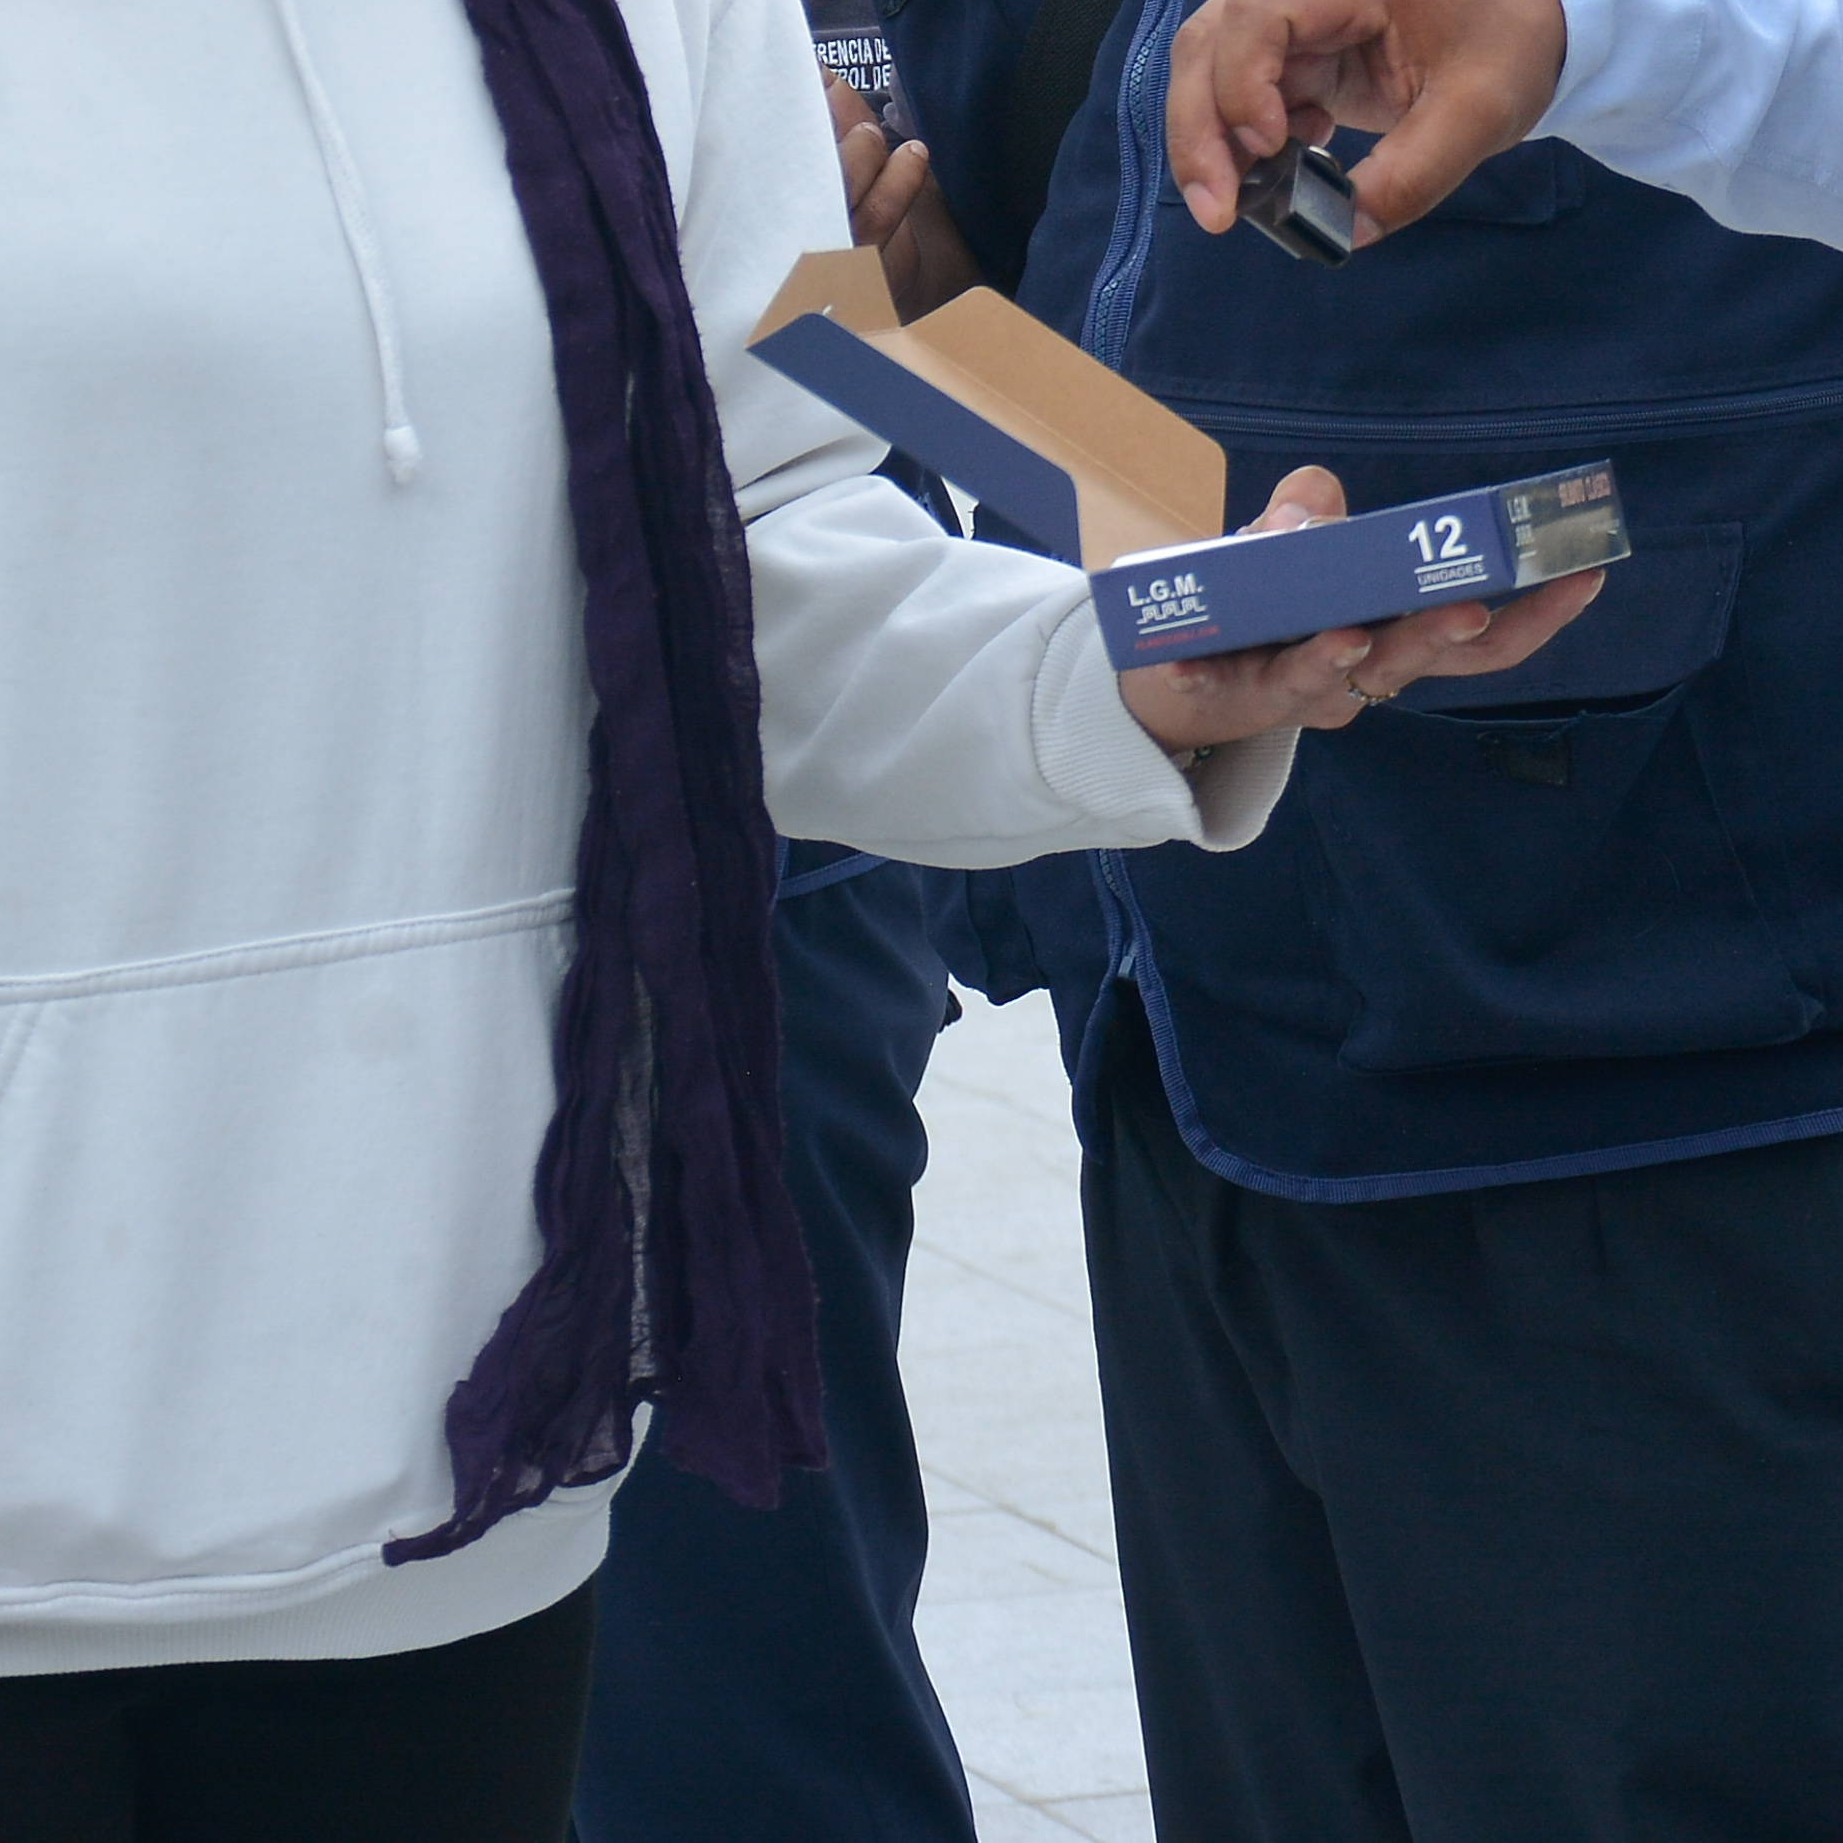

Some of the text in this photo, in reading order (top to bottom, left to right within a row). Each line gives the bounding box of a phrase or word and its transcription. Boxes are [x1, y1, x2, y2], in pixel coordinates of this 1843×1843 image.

[813, 38, 875, 67] RENCIA
[1408, 514, 1469, 563] 12
[1127, 573, 1205, 608] L.G.M.
